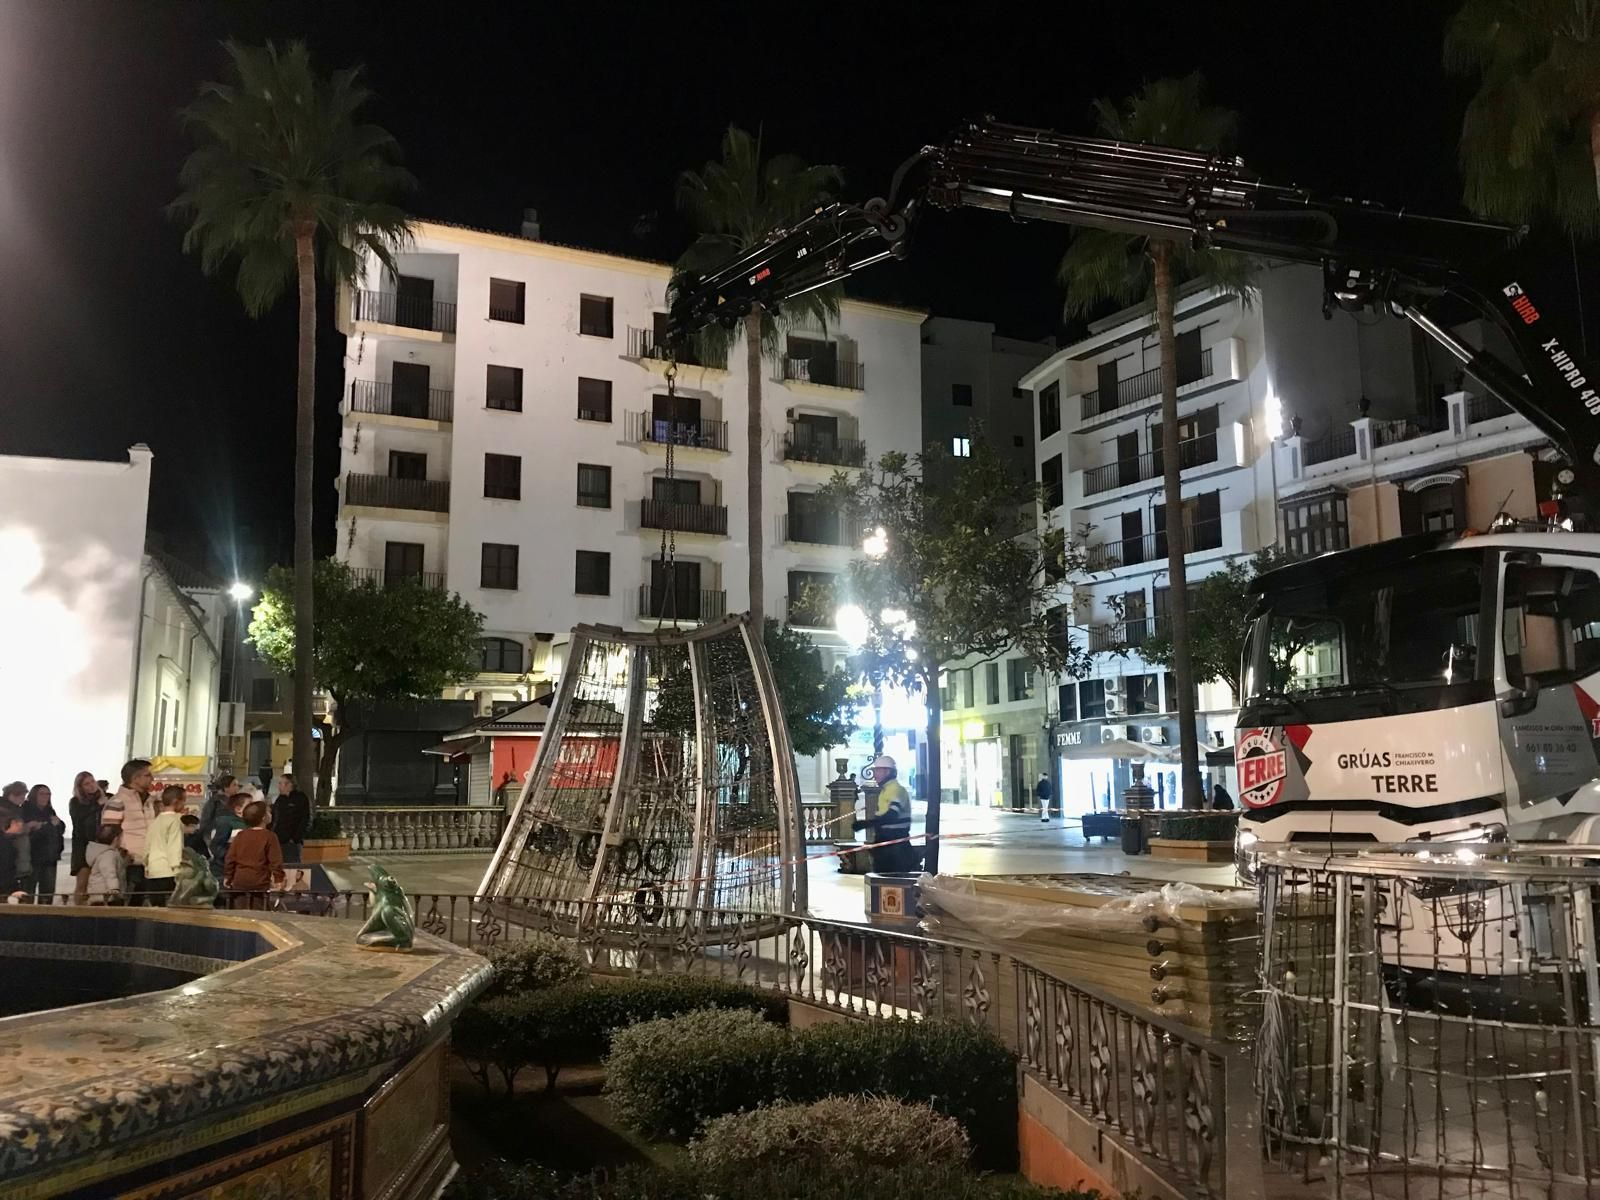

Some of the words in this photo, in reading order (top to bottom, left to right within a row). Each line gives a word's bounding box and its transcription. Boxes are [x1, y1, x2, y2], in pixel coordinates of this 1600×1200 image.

[1512, 295, 1540, 325] HIAB
[1541, 337, 1587, 389] X-HIPRO
[1056, 731, 1081, 746] FEMME
[1337, 748, 1391, 769] GRÚAS
[1371, 773, 1438, 793] TERRE
